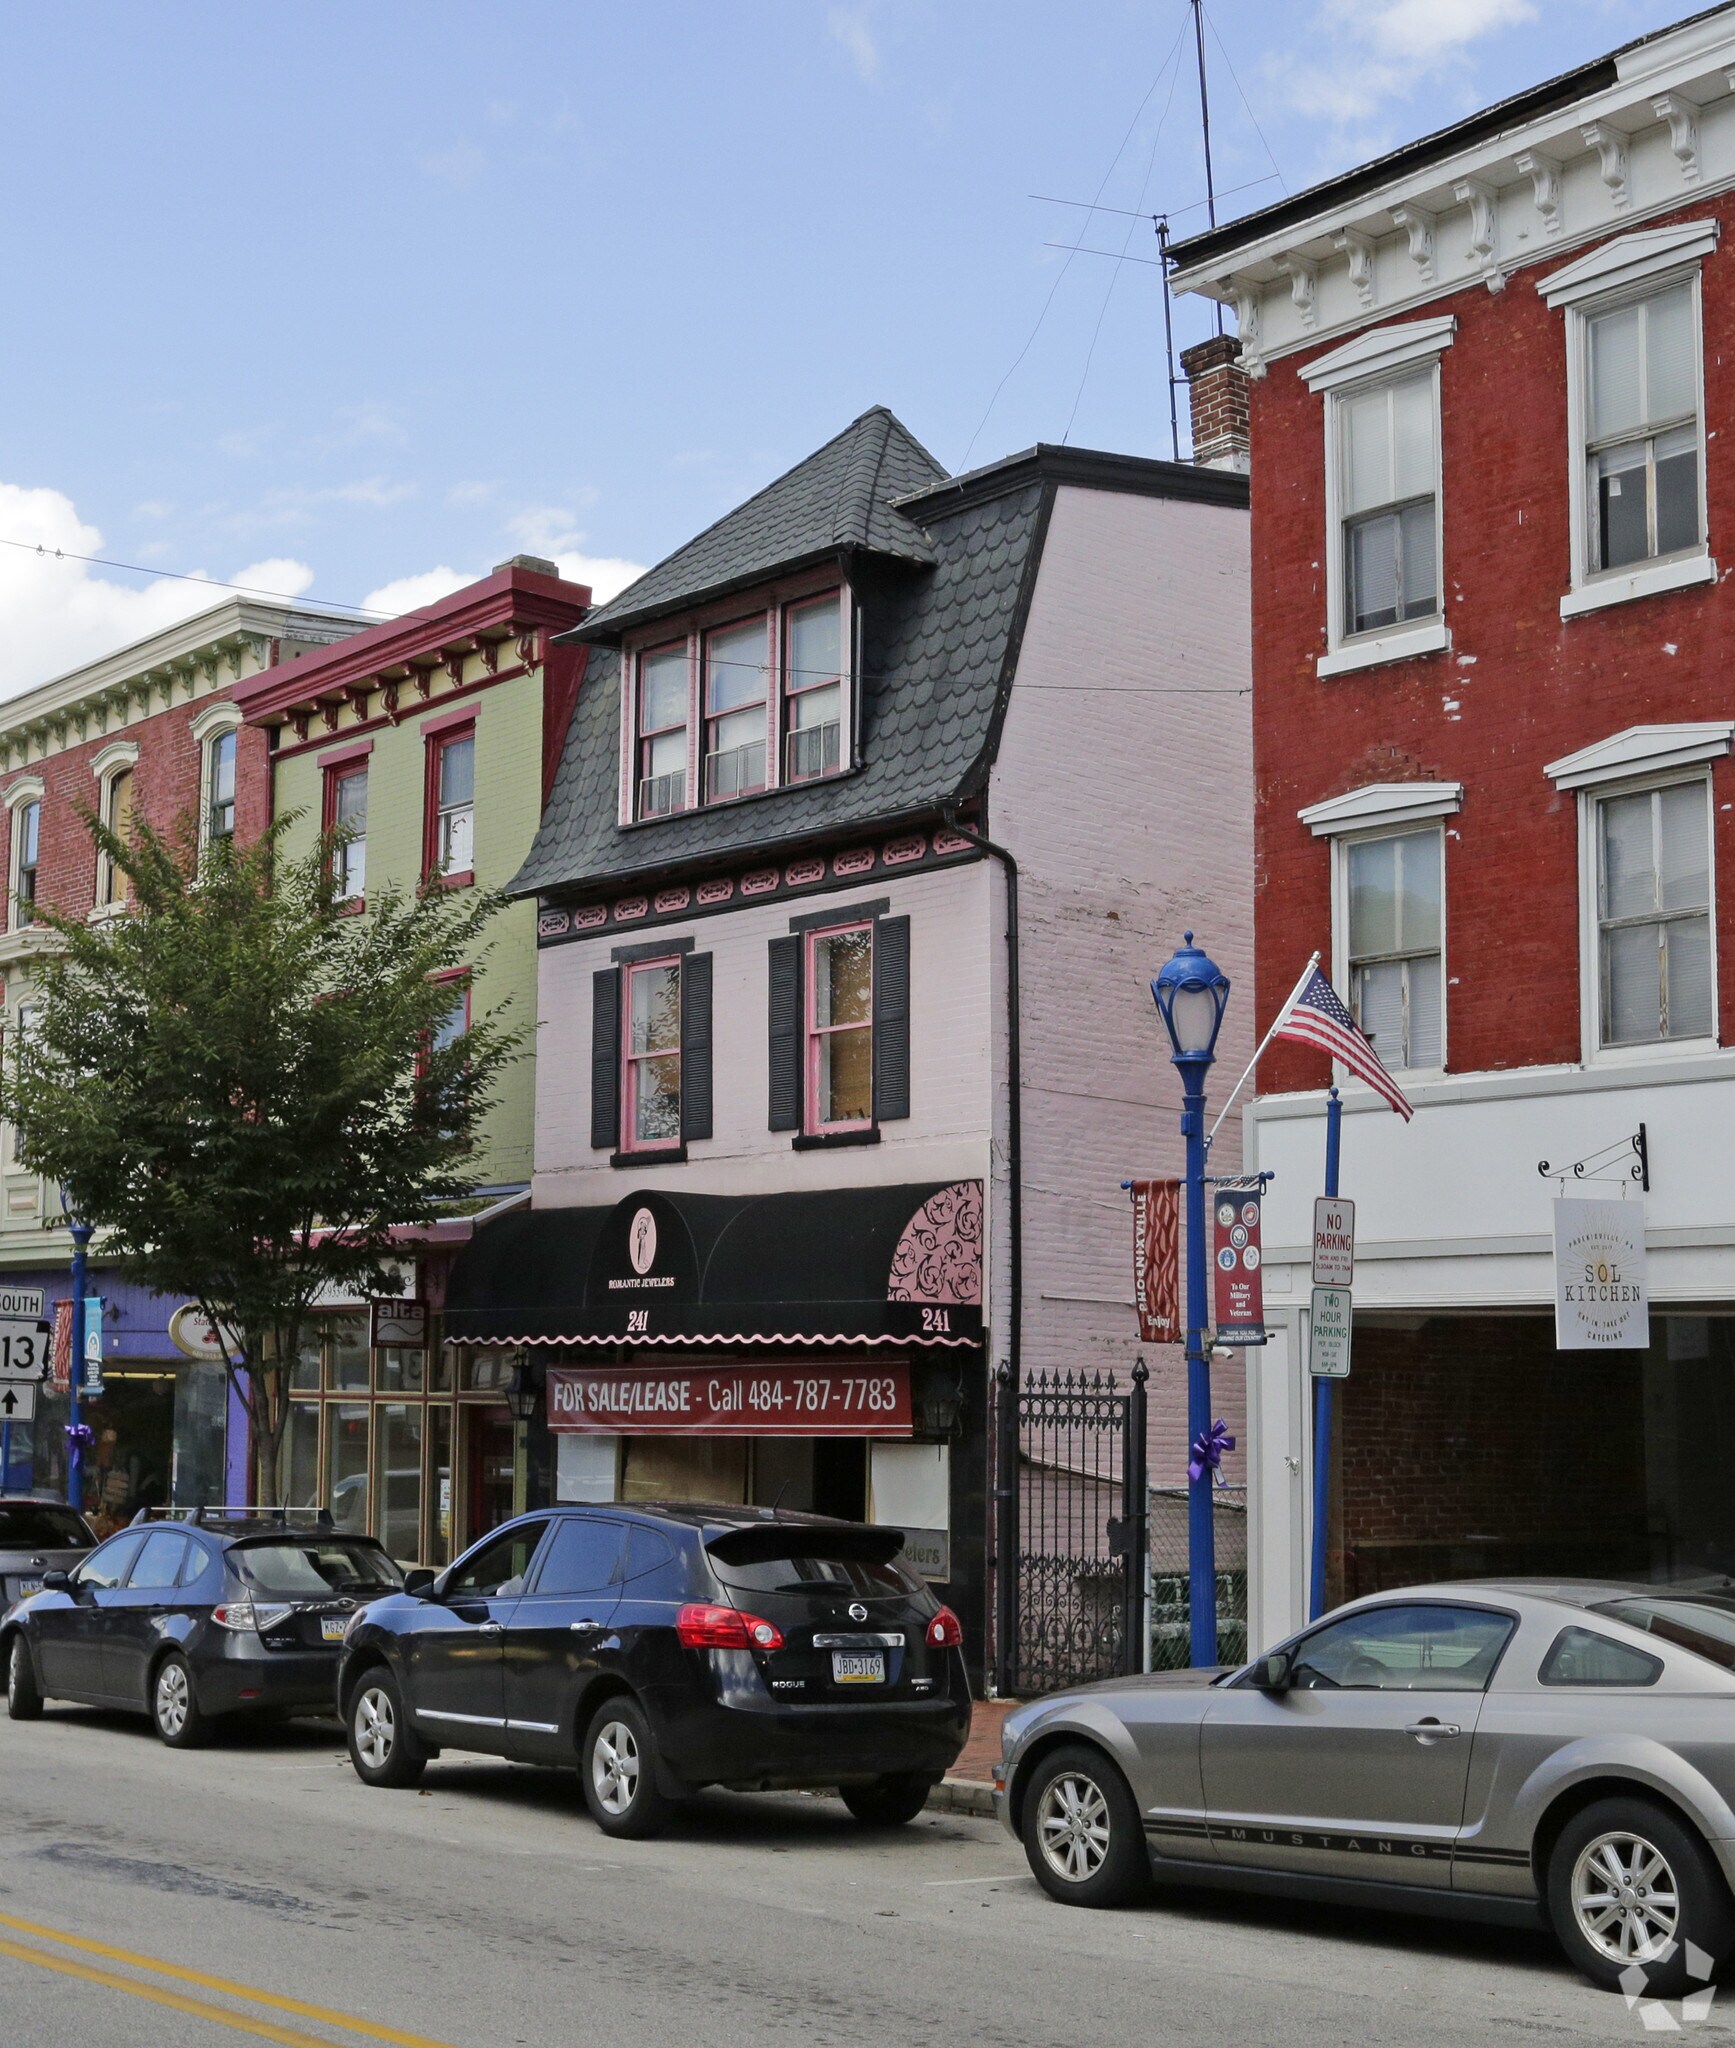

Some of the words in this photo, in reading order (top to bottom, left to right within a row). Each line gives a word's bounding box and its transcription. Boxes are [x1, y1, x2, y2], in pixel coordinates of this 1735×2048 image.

[1327, 1214, 1341, 1230] NO
[1316, 1232, 1351, 1251] PARKING
[1136, 1194, 1147, 1311] PHOENIXVILLE
[1585, 1264, 1621, 1283] SOL
[608, 1279, 640, 1289] ROMANTIC
[641, 1277, 675, 1288] JEWELERS
[1230, 1292, 1250, 1300] Military
[1565, 1285, 1640, 1301] KITCHEN
[0, 1294, 39, 1312] OUTH
[378, 1301, 424, 1318] alta
[1324, 1296, 1339, 1307] TWO
[627, 1310, 648, 1331] 241
[922, 1308, 950, 1332] 241
[1229, 1309, 1252, 1317] Veterans
[1320, 1311, 1341, 1323] HOUR
[1147, 1315, 1170, 1328] Enjoy
[1313, 1325, 1347, 1338] PARKING
[1587, 1330, 1622, 1342] CATERING
[554, 1383, 585, 1411] FOR
[588, 1381, 691, 1415] SALE/LEASE
[708, 1379, 742, 1411] Call
[748, 1378, 896, 1411] 484-787-7783
[902, 1541, 940, 1564] elers
[1231, 1828, 1426, 1856] MUSTANG
